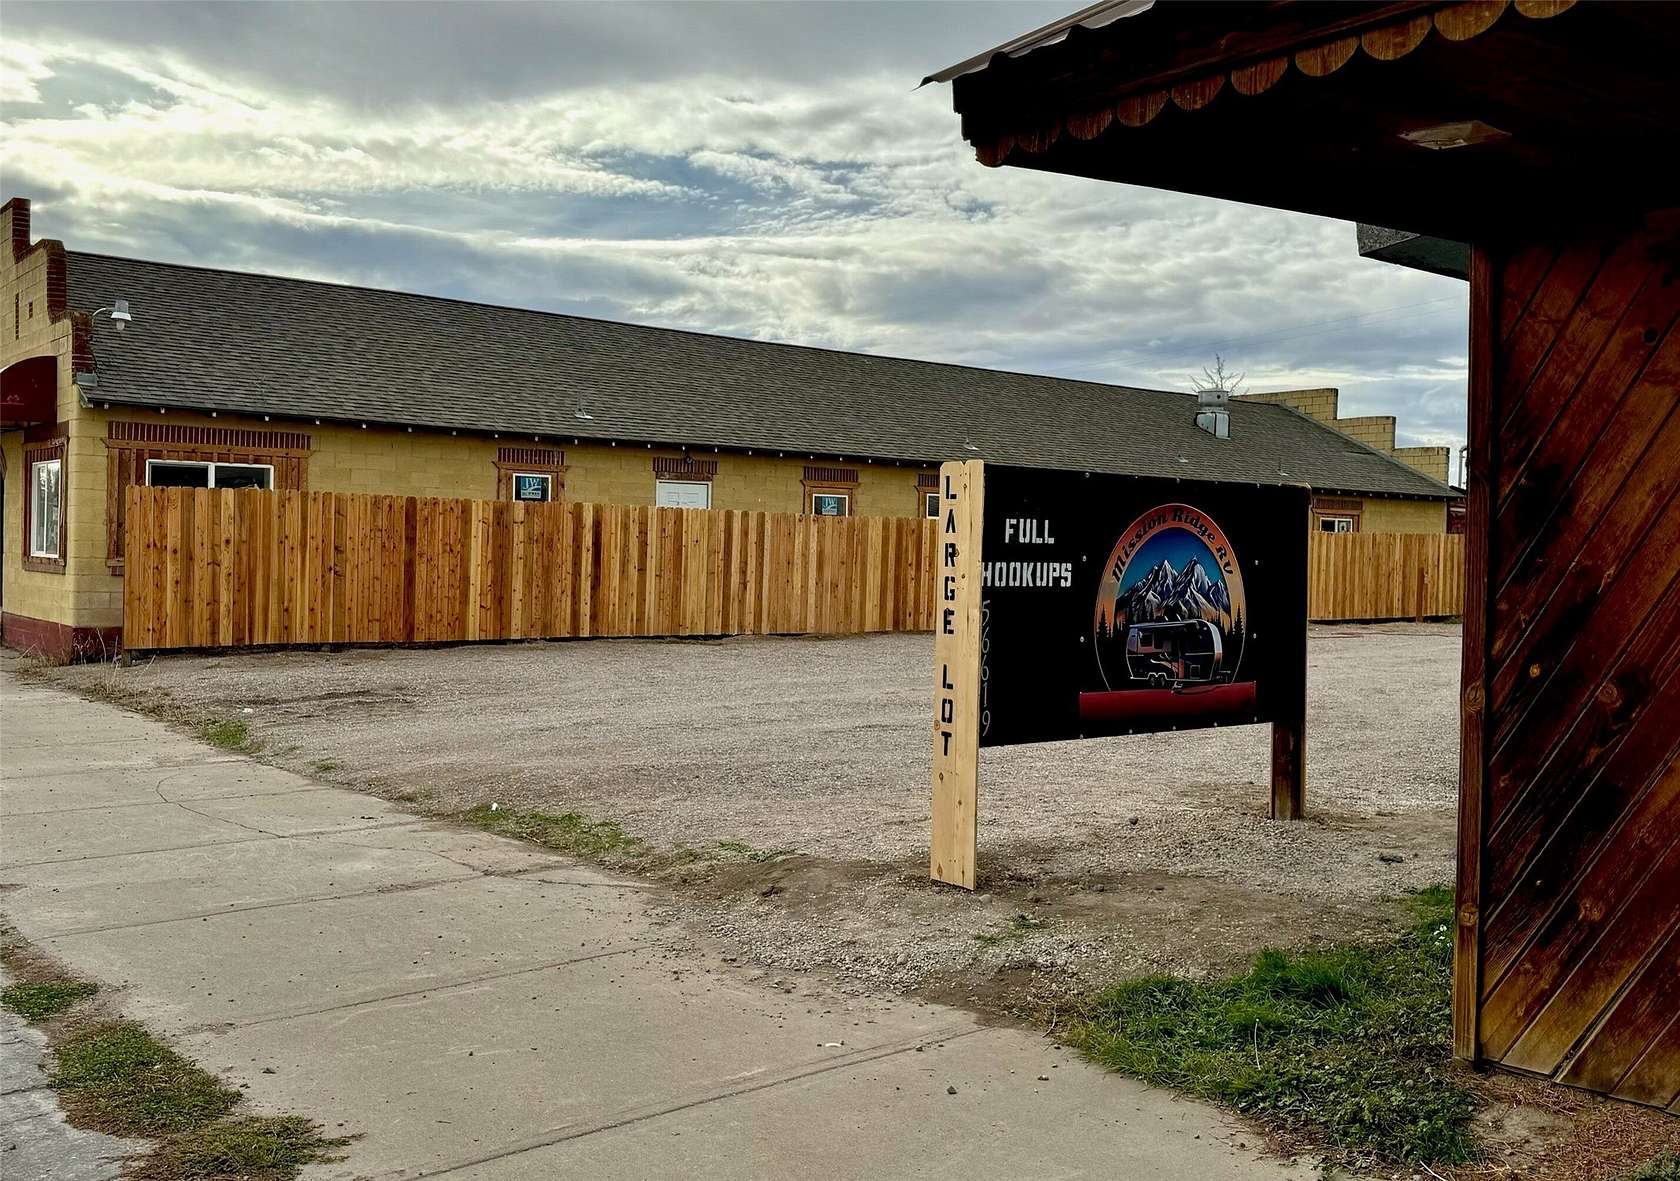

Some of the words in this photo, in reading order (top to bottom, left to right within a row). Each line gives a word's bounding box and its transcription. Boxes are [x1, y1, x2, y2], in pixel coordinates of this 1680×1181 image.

[943, 475, 957, 634] LARGE
[1004, 518, 1055, 544] FULL
[1111, 510, 1169, 583] Mission
[1171, 508, 1216, 544] Ridge
[1215, 543, 1234, 575] RV
[981, 561, 1072, 587] HOOKUPS
[940, 664, 954, 756] LOT
